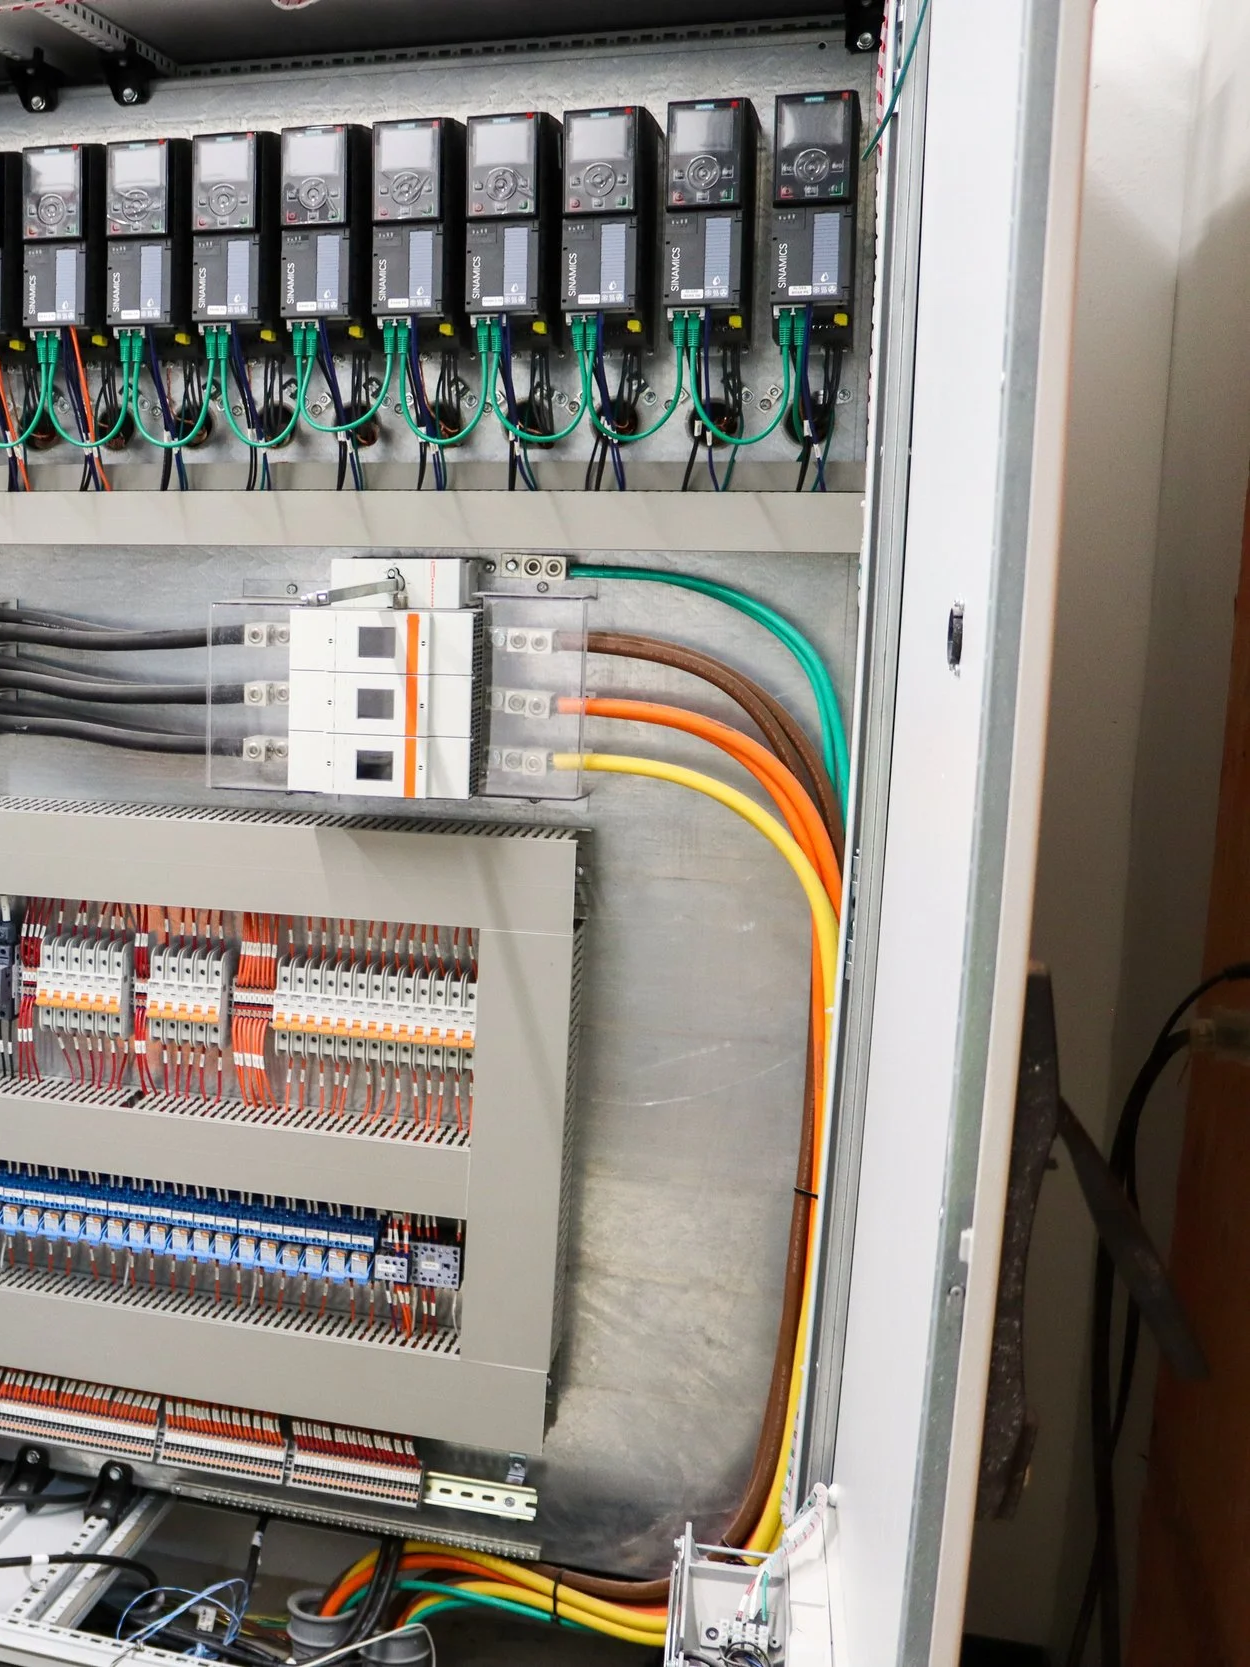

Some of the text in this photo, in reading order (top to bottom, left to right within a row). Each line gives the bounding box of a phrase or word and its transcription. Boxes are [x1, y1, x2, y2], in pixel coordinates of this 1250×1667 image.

[286, 262, 295, 304] SINAMICS
[378, 259, 387, 301] SINAMICS
[472, 256, 481, 299] SINAMICS
[568, 252, 577, 296] SINAMICS
[671, 247, 680, 292] SINAMICS
[778, 243, 788, 288] SINAMICS
[28, 275, 37, 315] SINAMICS
[112, 272, 121, 313] SINAMICS
[198, 267, 207, 309] SINAMICS
